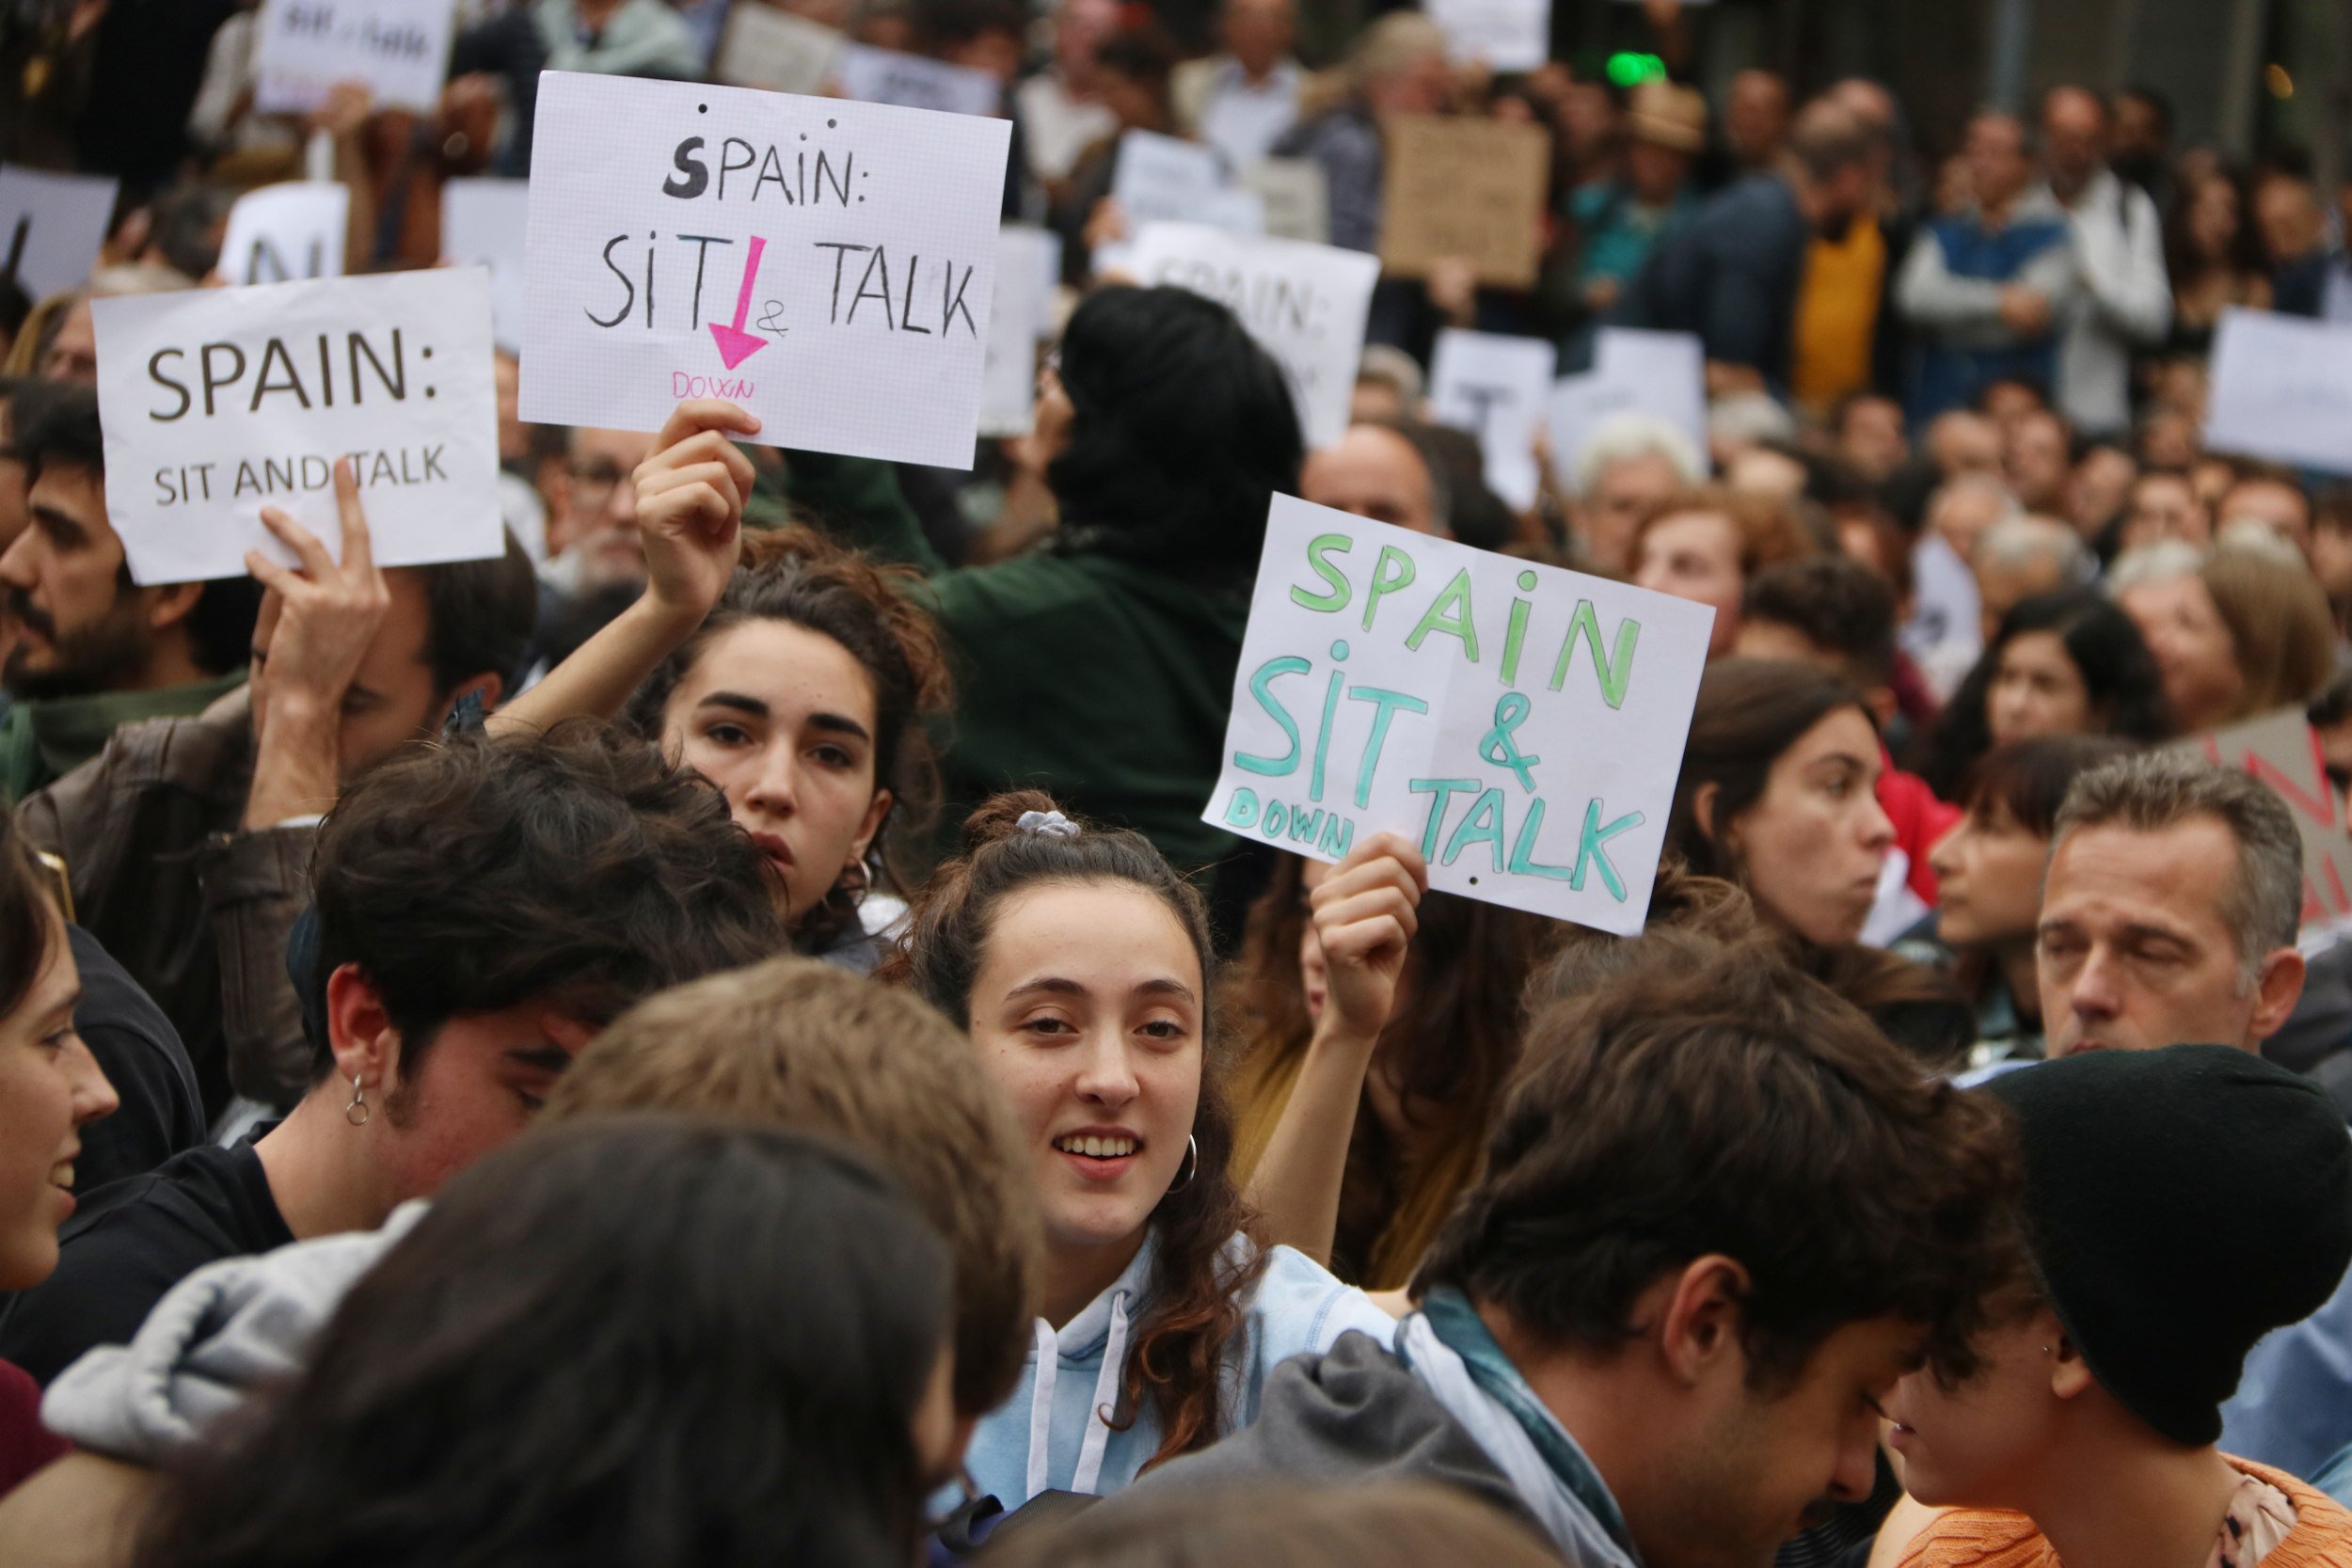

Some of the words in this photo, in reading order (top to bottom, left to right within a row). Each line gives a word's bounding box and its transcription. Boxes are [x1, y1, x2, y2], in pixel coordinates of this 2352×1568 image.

[755, 299, 789, 338] &
[813, 242, 977, 340] TALK
[147, 326, 437, 422] SPAIN:
[672, 371, 755, 400] DOWN
[154, 463, 215, 507] SIT
[233, 454, 329, 499] AND
[346, 443, 449, 490] TALK
[1478, 692, 1541, 794] &
[1222, 786, 1355, 860] DOWN
[1409, 778, 1645, 904] TALK
